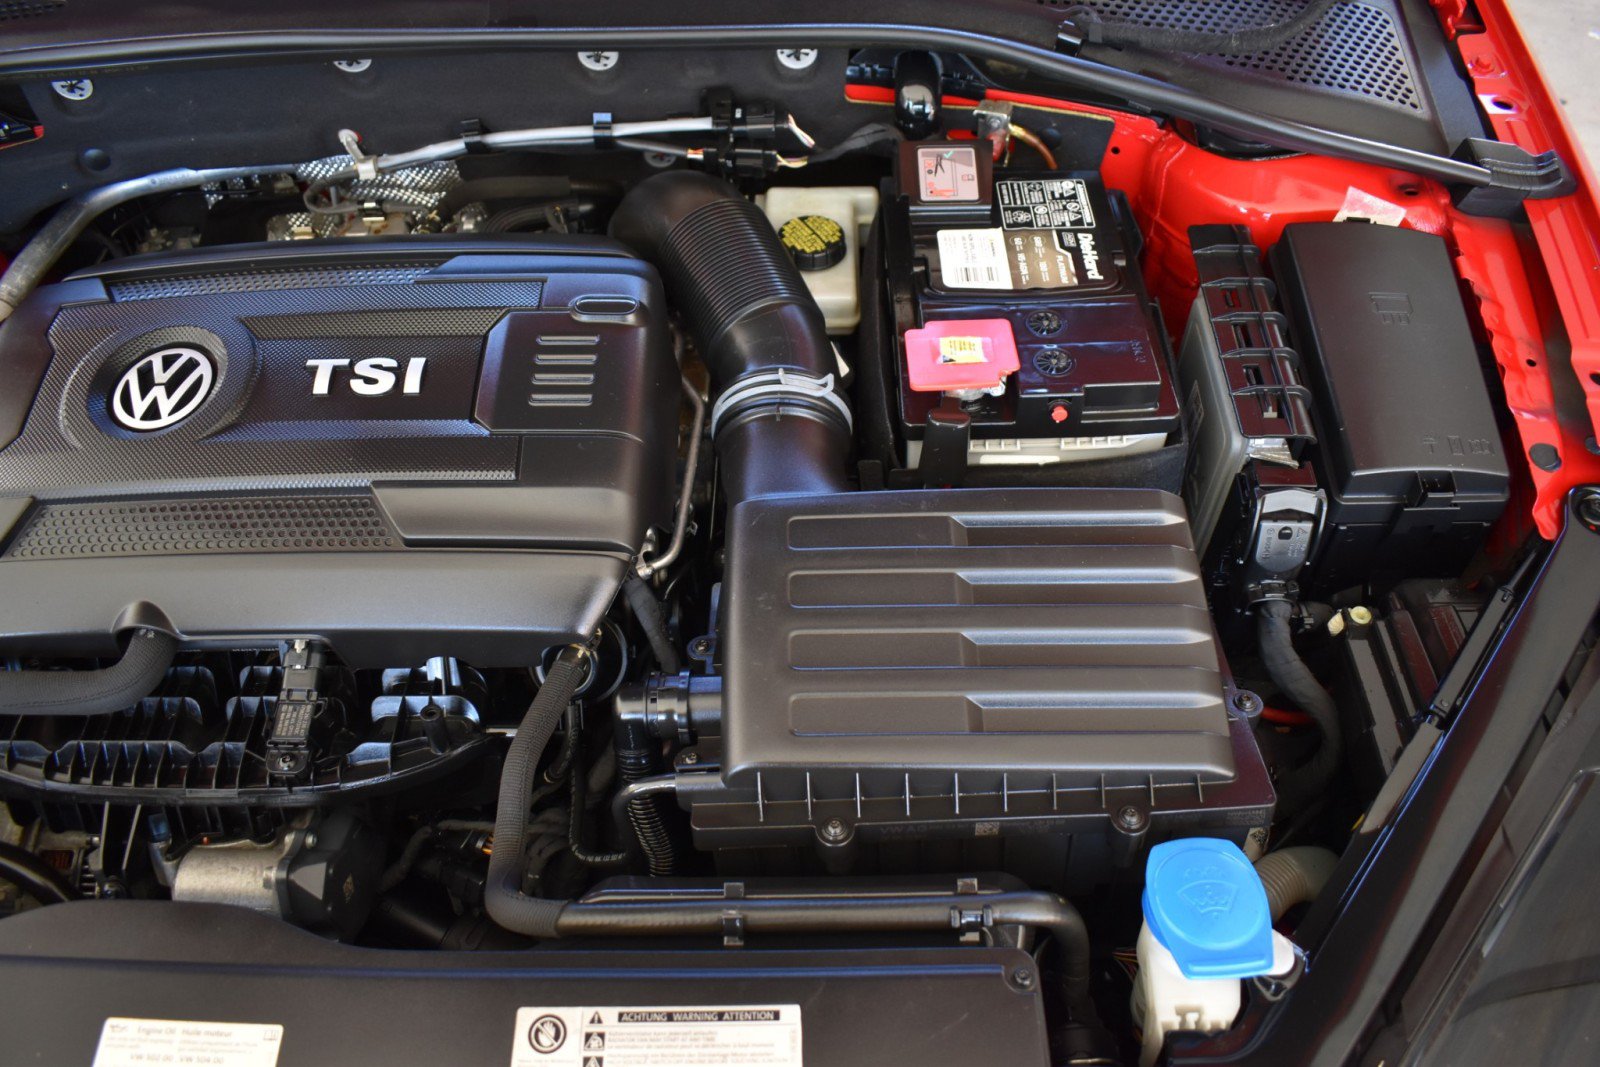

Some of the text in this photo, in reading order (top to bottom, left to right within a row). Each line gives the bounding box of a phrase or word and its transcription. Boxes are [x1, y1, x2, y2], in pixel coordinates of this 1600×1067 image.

[1077, 232, 1103, 280] DieHard
[305, 357, 428, 395] TSI
[621, 1010, 774, 1022] ACHTUNG WARNING ATTENTION
